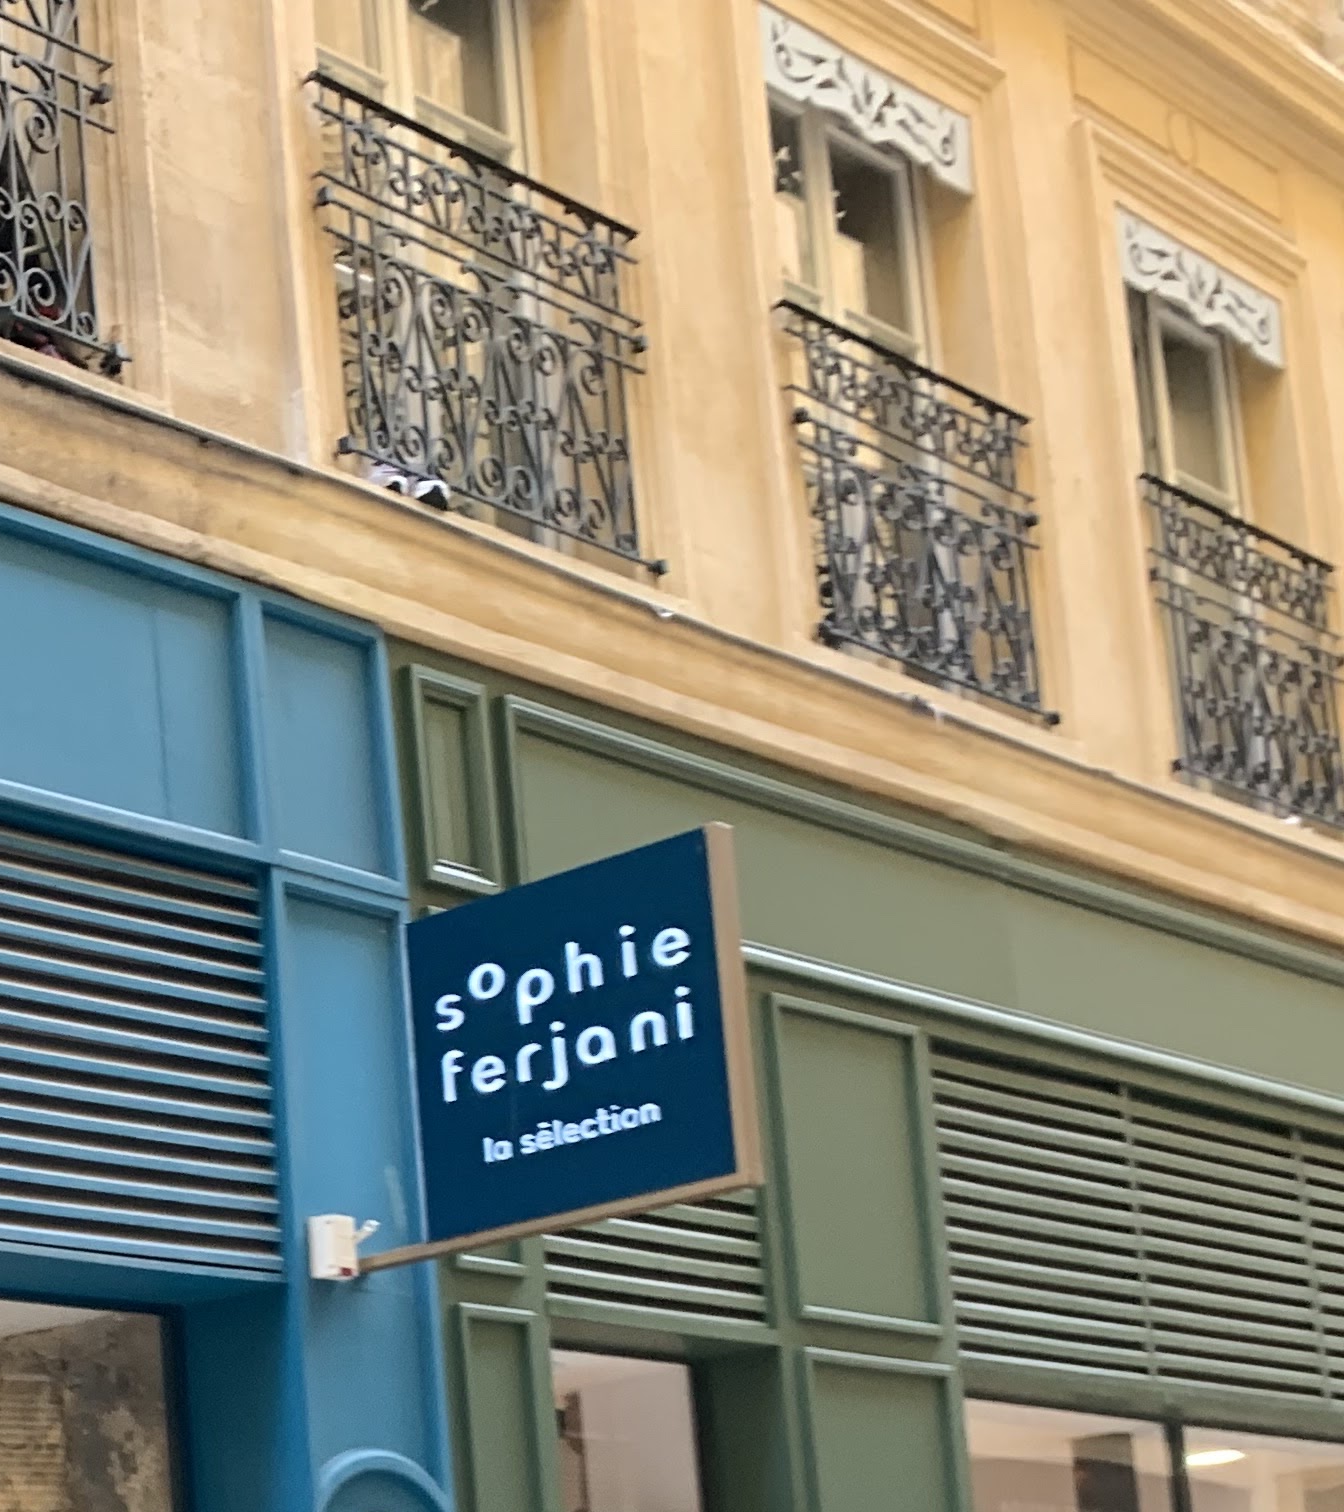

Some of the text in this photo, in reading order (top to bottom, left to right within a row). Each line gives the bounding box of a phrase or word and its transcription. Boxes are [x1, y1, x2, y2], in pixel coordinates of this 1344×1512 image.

[434, 925, 692, 1033] sophie
[440, 986, 695, 1104] ferjani
[482, 1102, 663, 1164] la sélection
